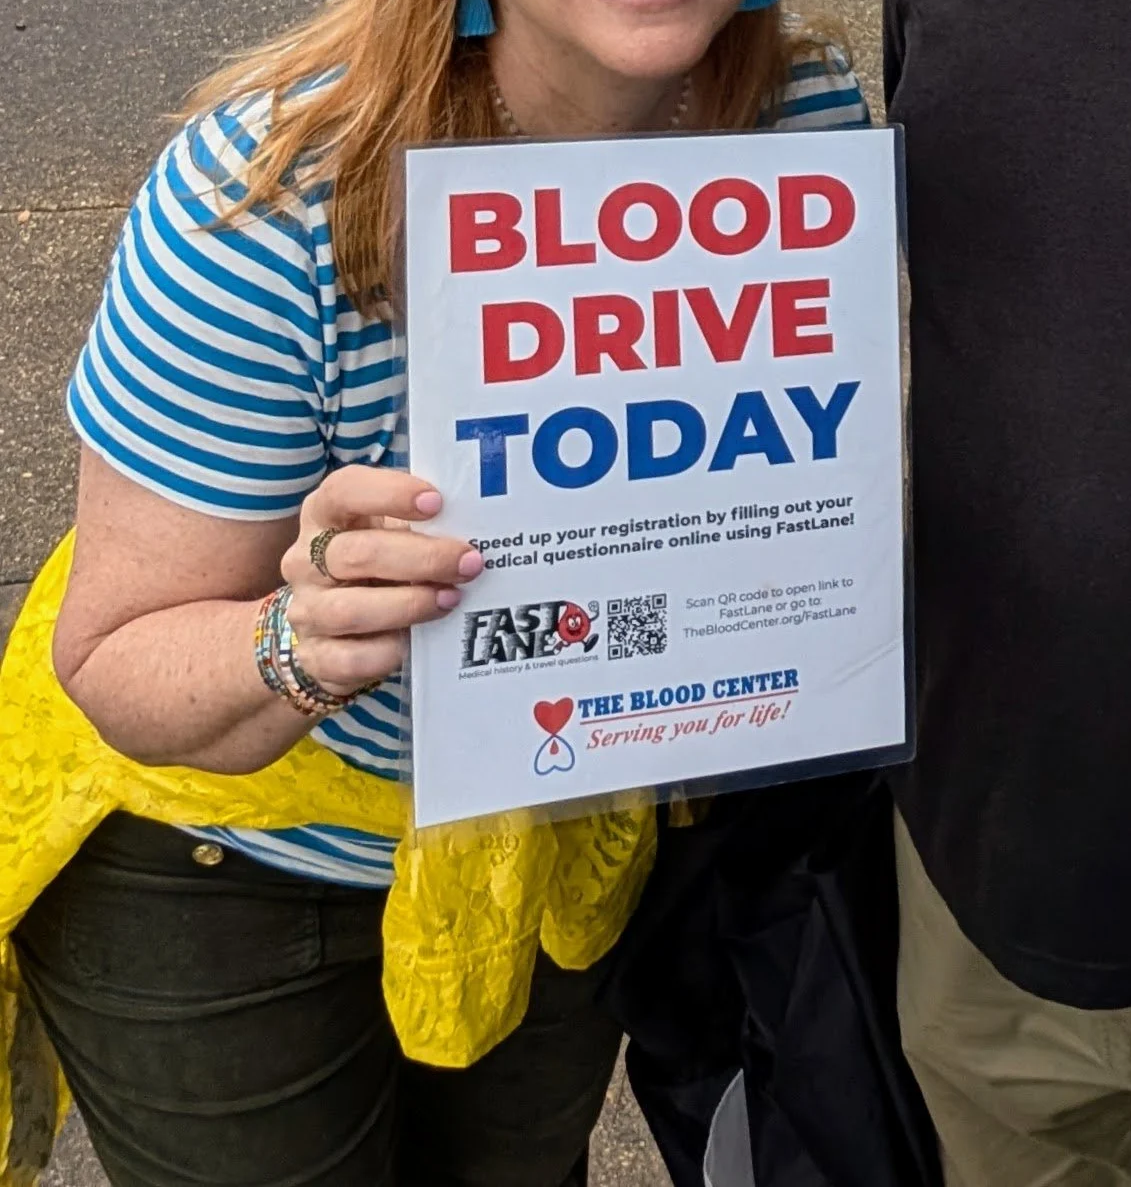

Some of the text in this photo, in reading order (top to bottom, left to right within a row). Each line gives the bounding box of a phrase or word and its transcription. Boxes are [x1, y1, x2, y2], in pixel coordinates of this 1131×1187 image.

[448, 174, 856, 274] BLOOD
[482, 278, 834, 384] DRIVE
[455, 380, 861, 498] TODAY
[468, 496, 853, 553] Speed up your registration by filling out your
[484, 513, 855, 570] edical questionnaire online using FastLane!
[685, 577, 854, 609] Scan QR code to open link to
[719, 602, 773, 619] FastLane
[775, 601, 788, 611] or
[790, 599, 806, 612] go
[464, 600, 568, 639] FAST
[683, 605, 857, 638] TheBloodCenter.org/FastLane
[458, 654, 599, 680] Medical history & travel questions
[461, 630, 558, 670] LANE
[578, 668, 799, 718] THE BLOOD CENTER
[587, 700, 792, 750] Serving you for life!
